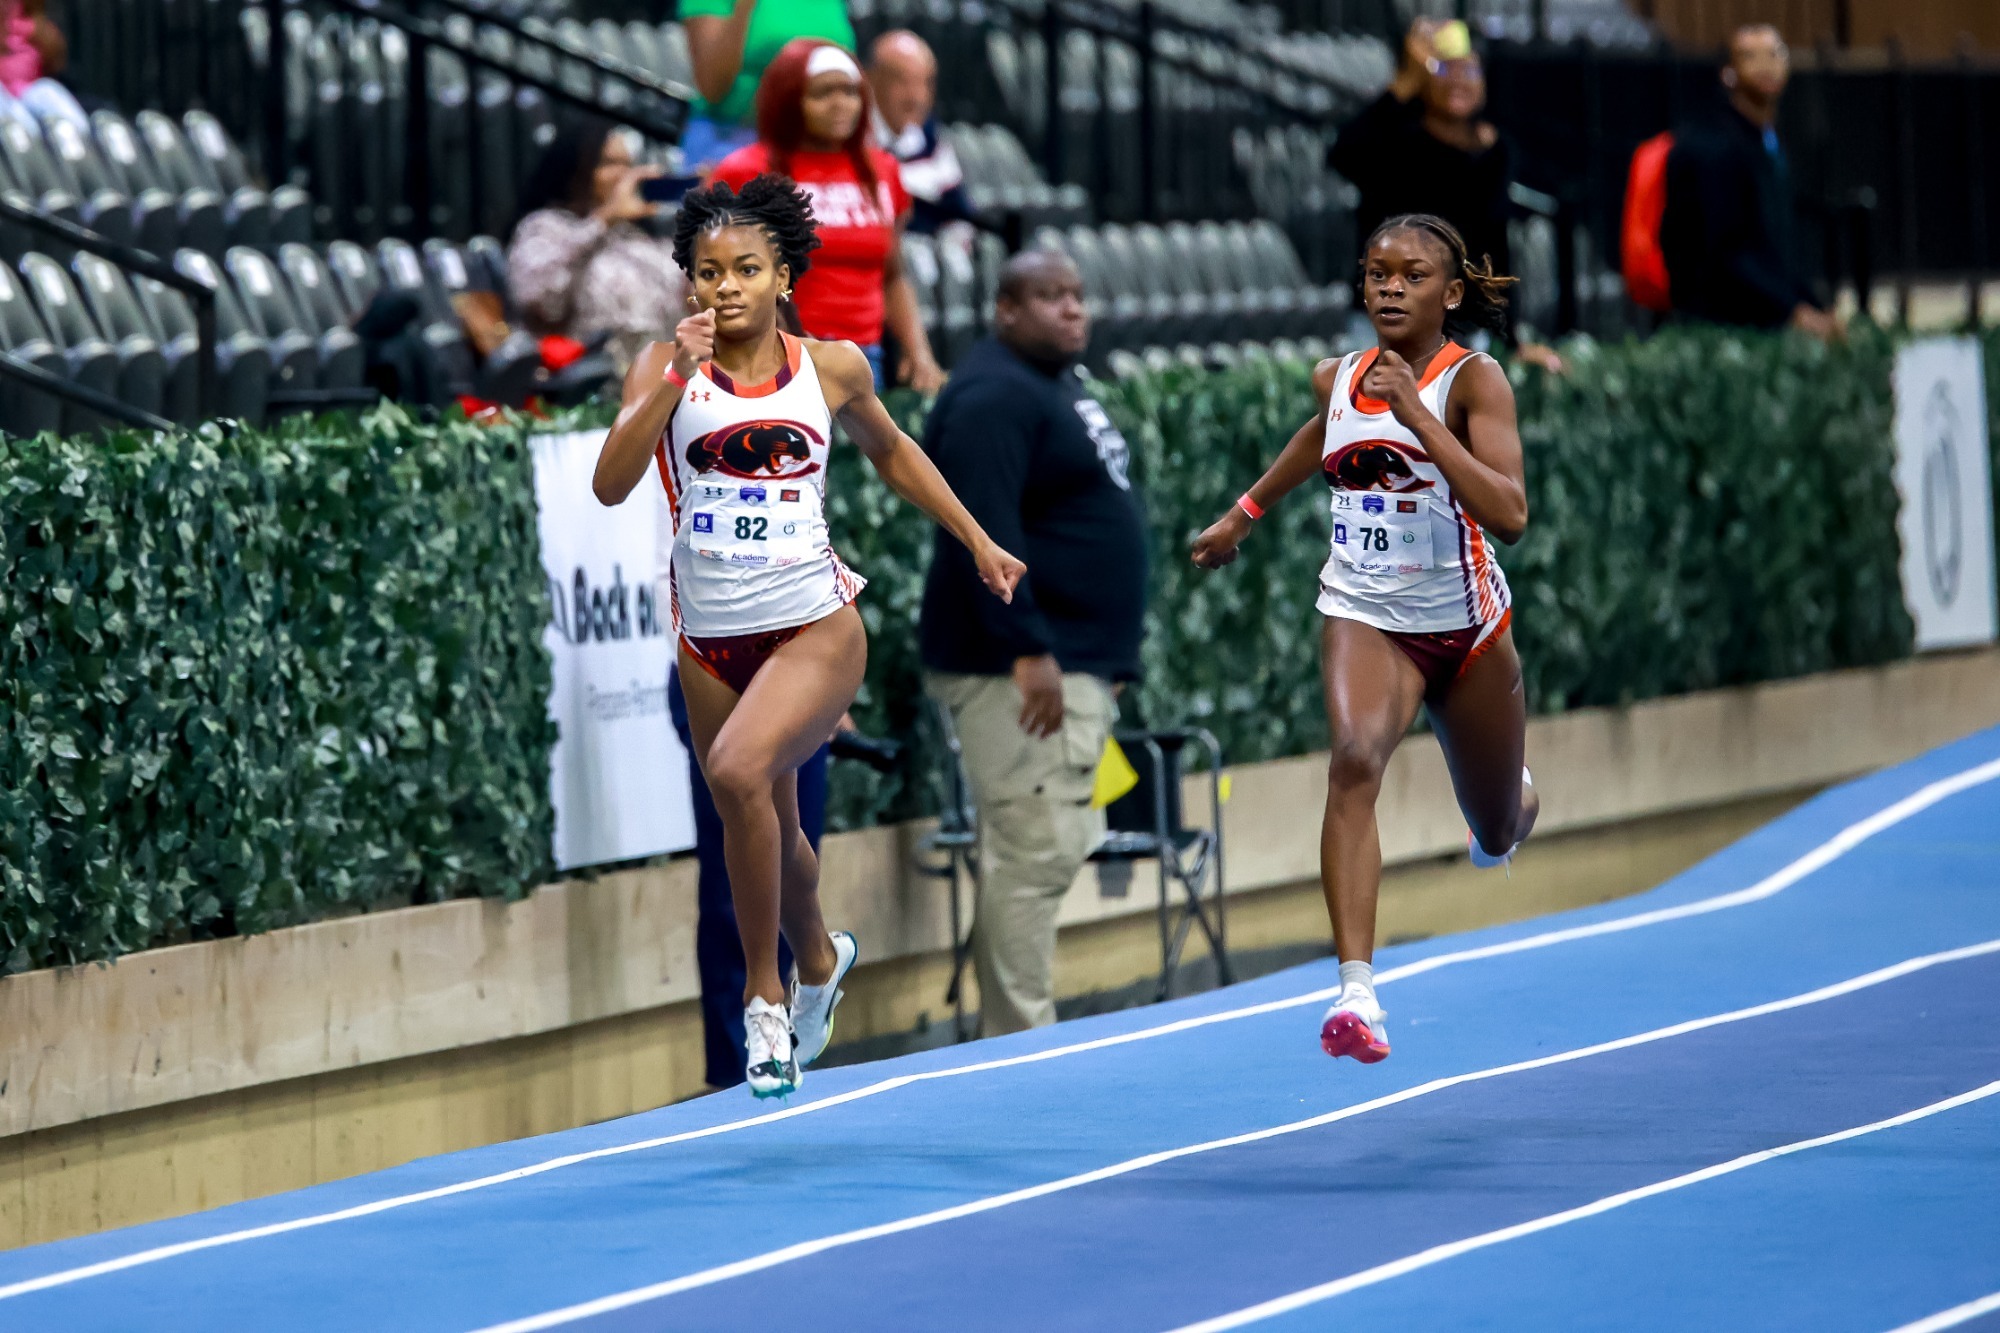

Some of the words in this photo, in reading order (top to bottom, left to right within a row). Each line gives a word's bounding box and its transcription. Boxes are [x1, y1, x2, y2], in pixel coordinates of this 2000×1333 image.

[735, 515, 768, 541] 82
[1359, 527, 1389, 552] 78
[731, 552, 769, 564] Academy
